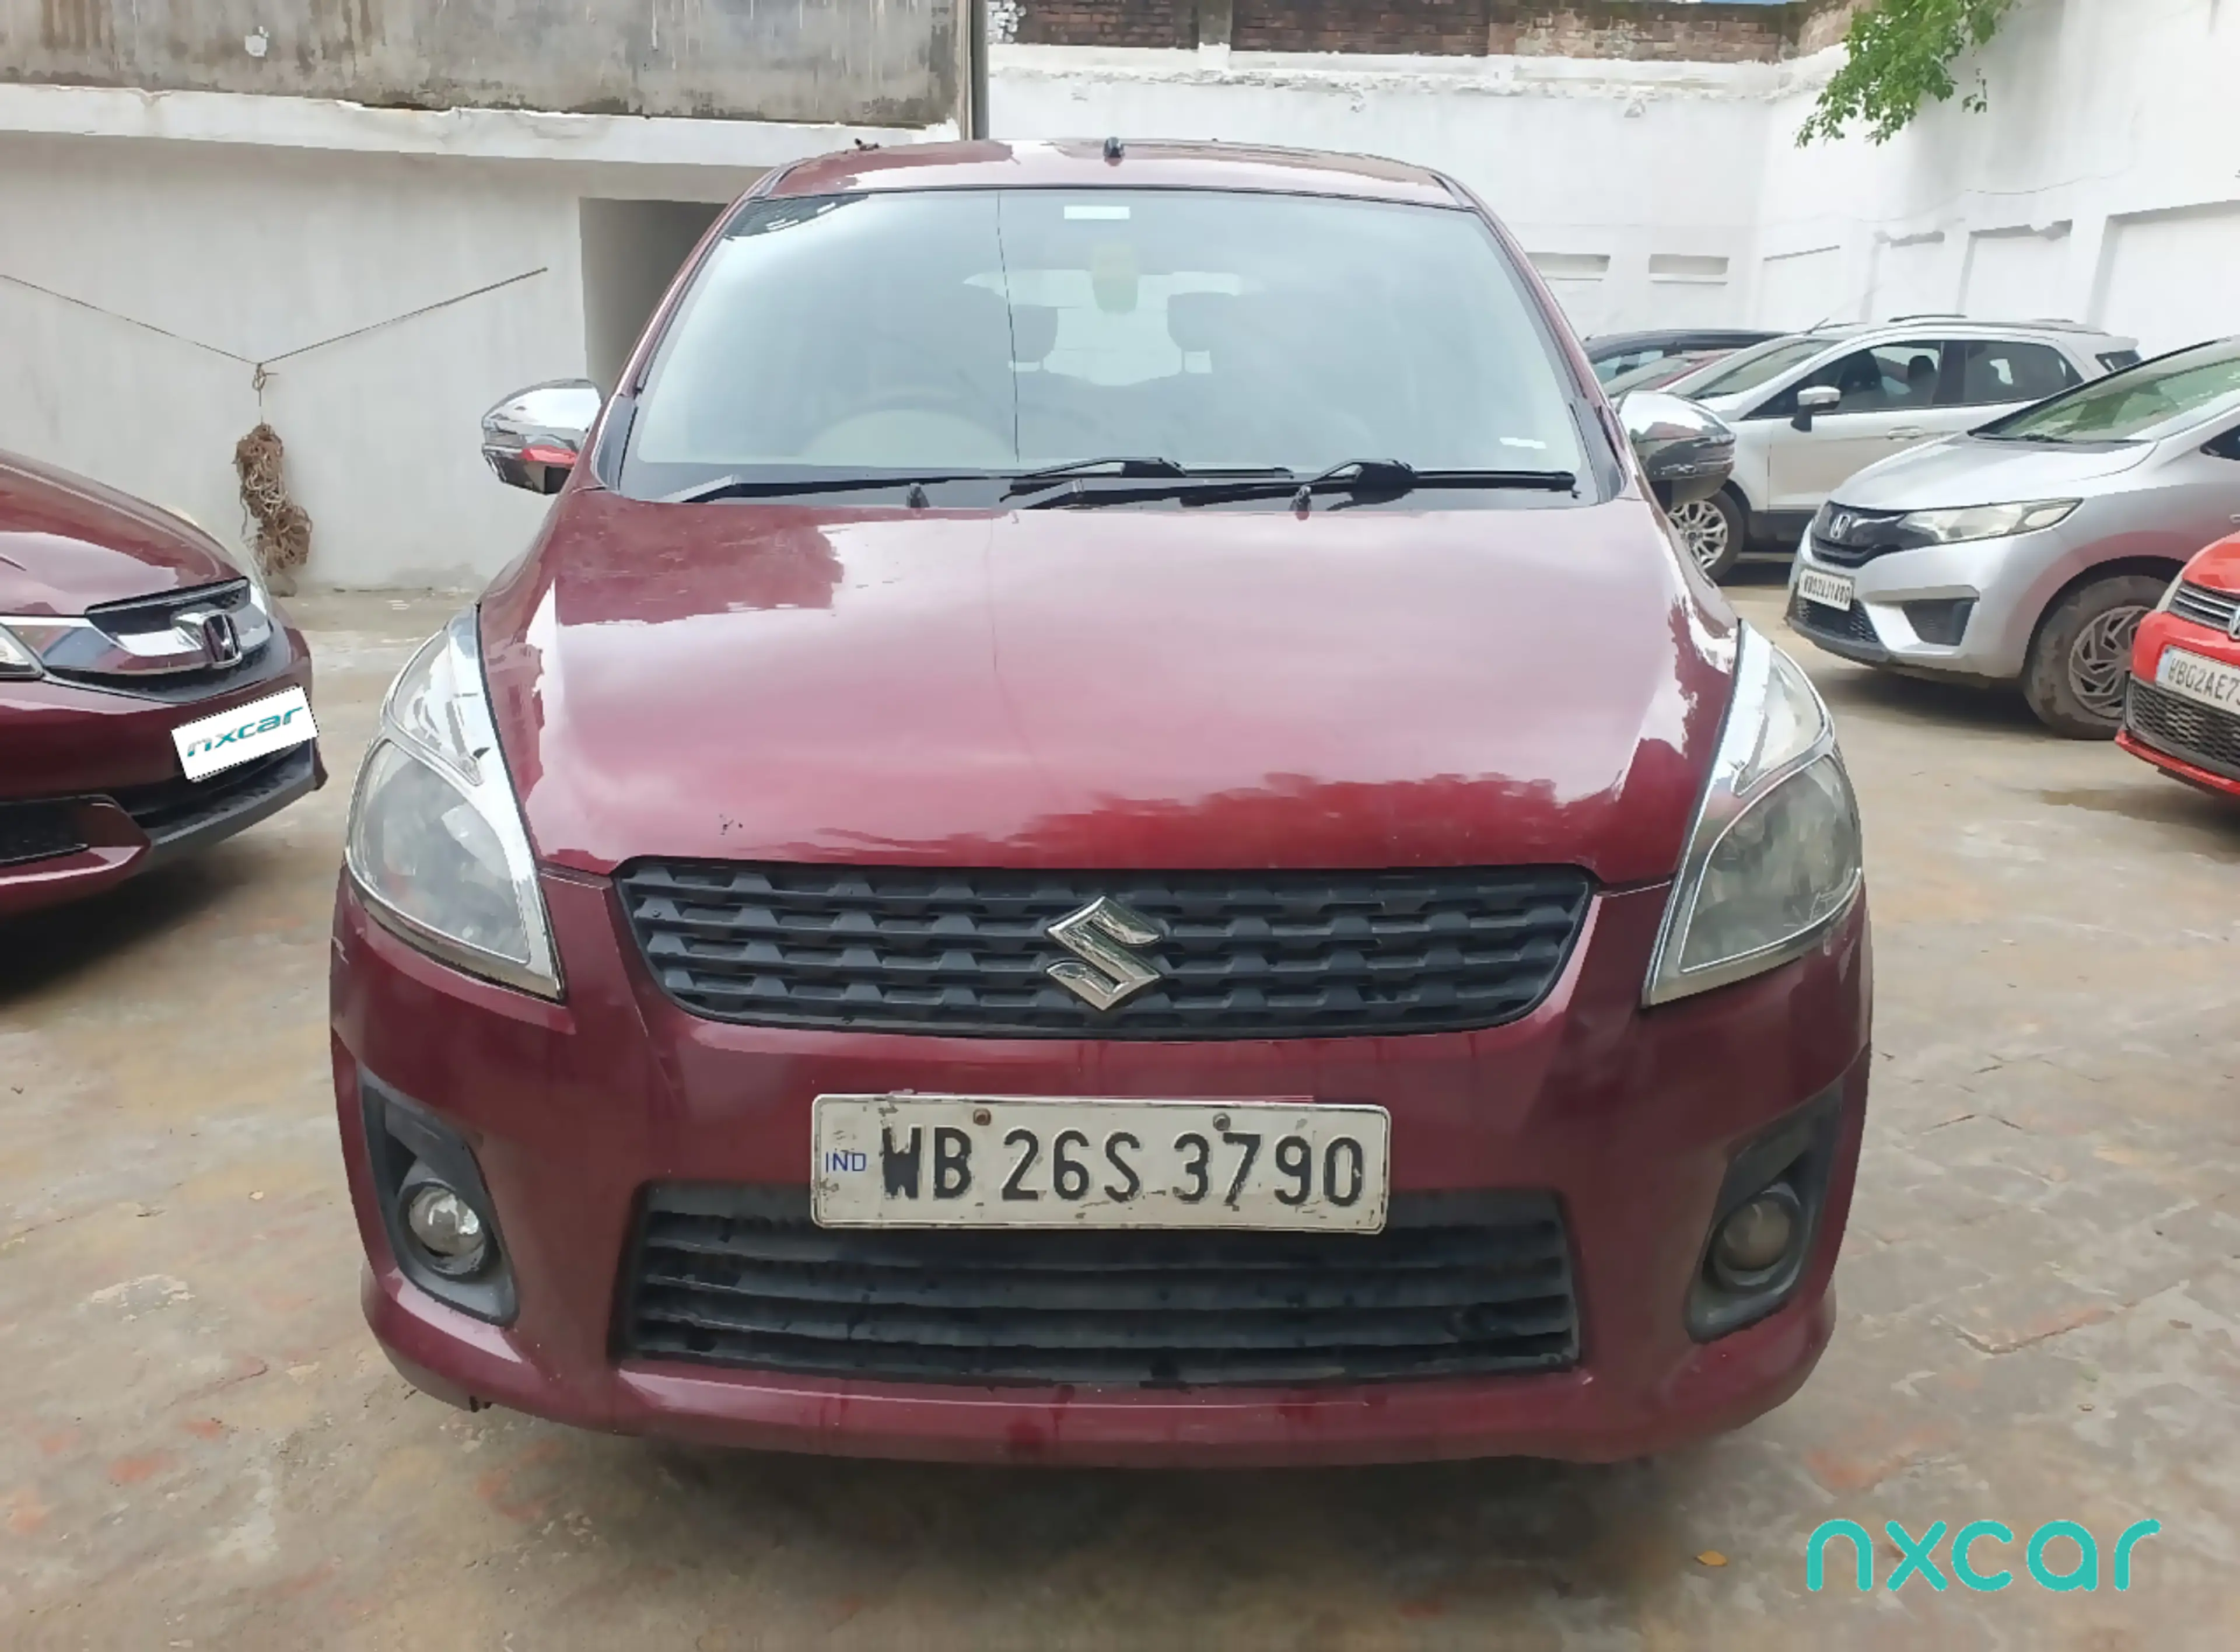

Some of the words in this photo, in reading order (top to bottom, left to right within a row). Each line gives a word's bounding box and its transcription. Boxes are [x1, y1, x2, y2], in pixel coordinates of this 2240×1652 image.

[825, 1152, 866, 1172] IND
[881, 1126, 973, 1200] WB
[1001, 1128, 1141, 1203] 26S
[1172, 1132, 1364, 1208] 3790
